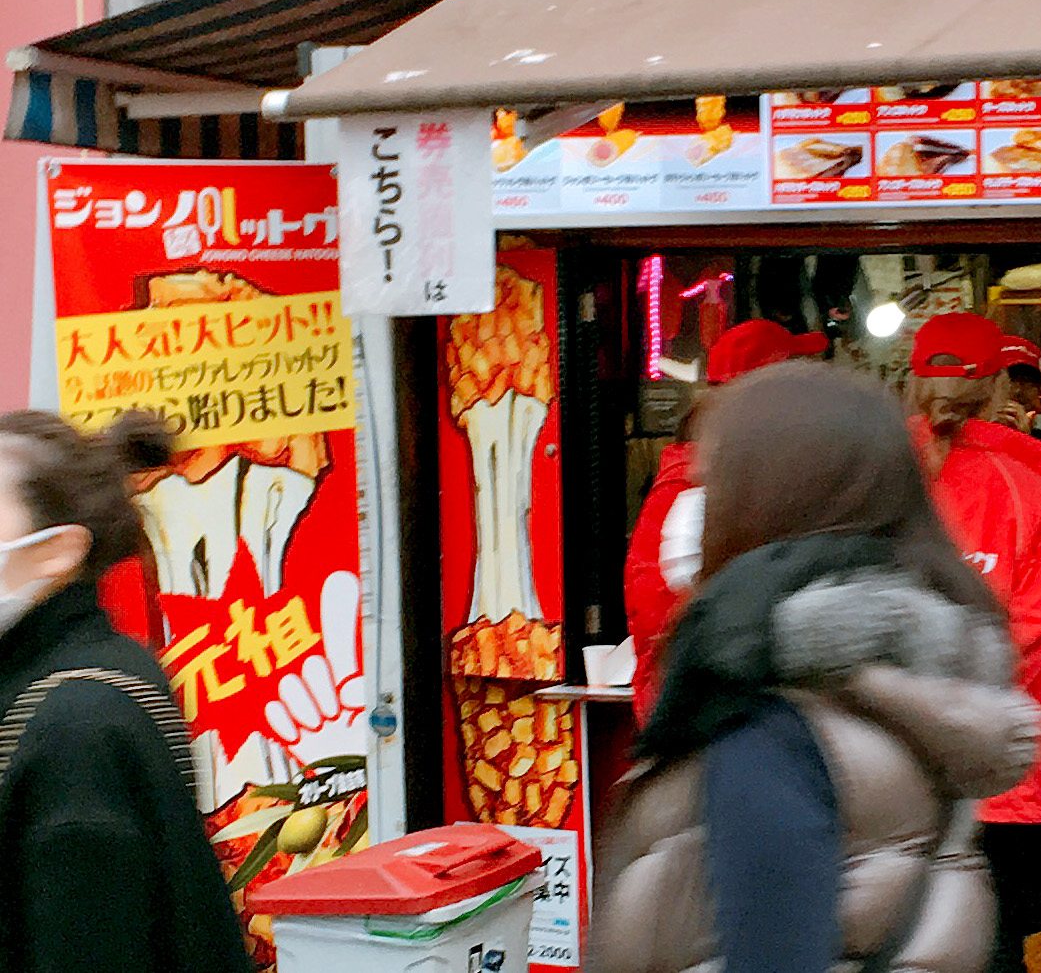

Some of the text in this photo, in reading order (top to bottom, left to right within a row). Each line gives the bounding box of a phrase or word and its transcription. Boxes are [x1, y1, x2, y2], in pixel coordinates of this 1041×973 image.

[370, 127, 403, 283] こちら!
[61, 300, 335, 371] 大人気!大ヒット!!
[158, 594, 322, 724] 元祖
